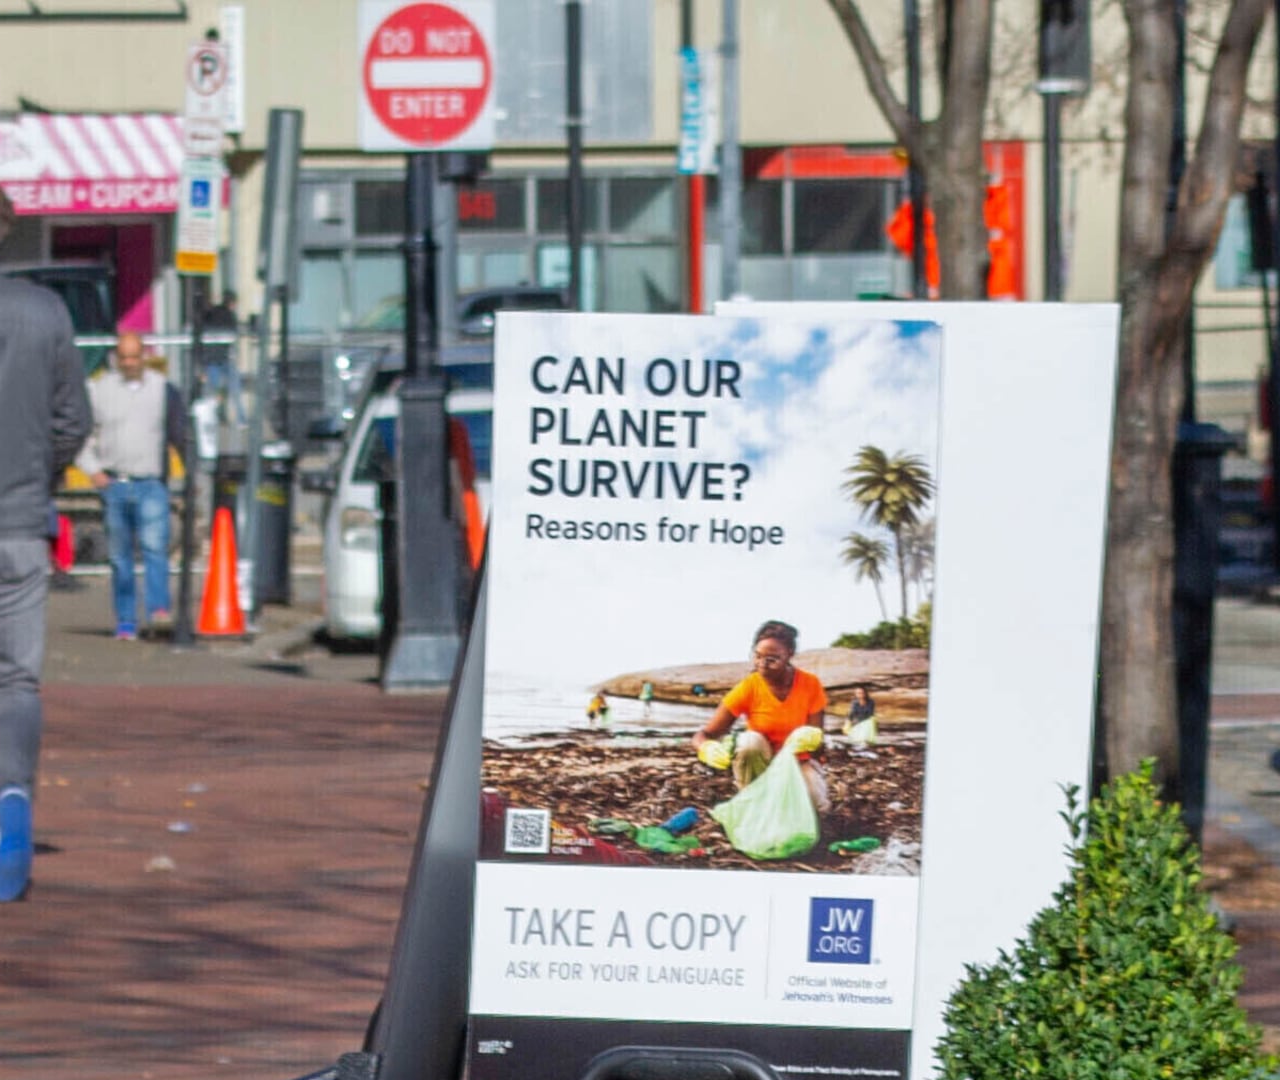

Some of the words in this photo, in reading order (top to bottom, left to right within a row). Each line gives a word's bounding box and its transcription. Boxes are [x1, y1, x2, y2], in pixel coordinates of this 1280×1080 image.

[381, 28, 413, 54] DO
[425, 28, 471, 54] NOT
[390, 94, 465, 119] ENTER
[531, 355, 625, 395] CAN
[646, 358, 741, 398] OUR
[530, 407, 706, 448] PLANET
[527, 458, 750, 501] SURVIVE?
[525, 514, 646, 541] Reasons
[658, 517, 700, 543] for
[709, 519, 784, 551] Hope
[505, 907, 595, 947] TAKE
[607, 910, 632, 949] A
[646, 912, 746, 952] COPY
[820, 907, 865, 933] JW
[815, 935, 863, 955] .ORG
[505, 960, 541, 980] ASK
[548, 961, 583, 982] FOR
[590, 964, 639, 983] YOUR
[647, 966, 745, 986] LANGUAGE
[788, 976, 828, 987] Official
[831, 977, 873, 989] Website
[875, 978, 888, 989] of
[837, 993, 893, 1005] Witnesses
